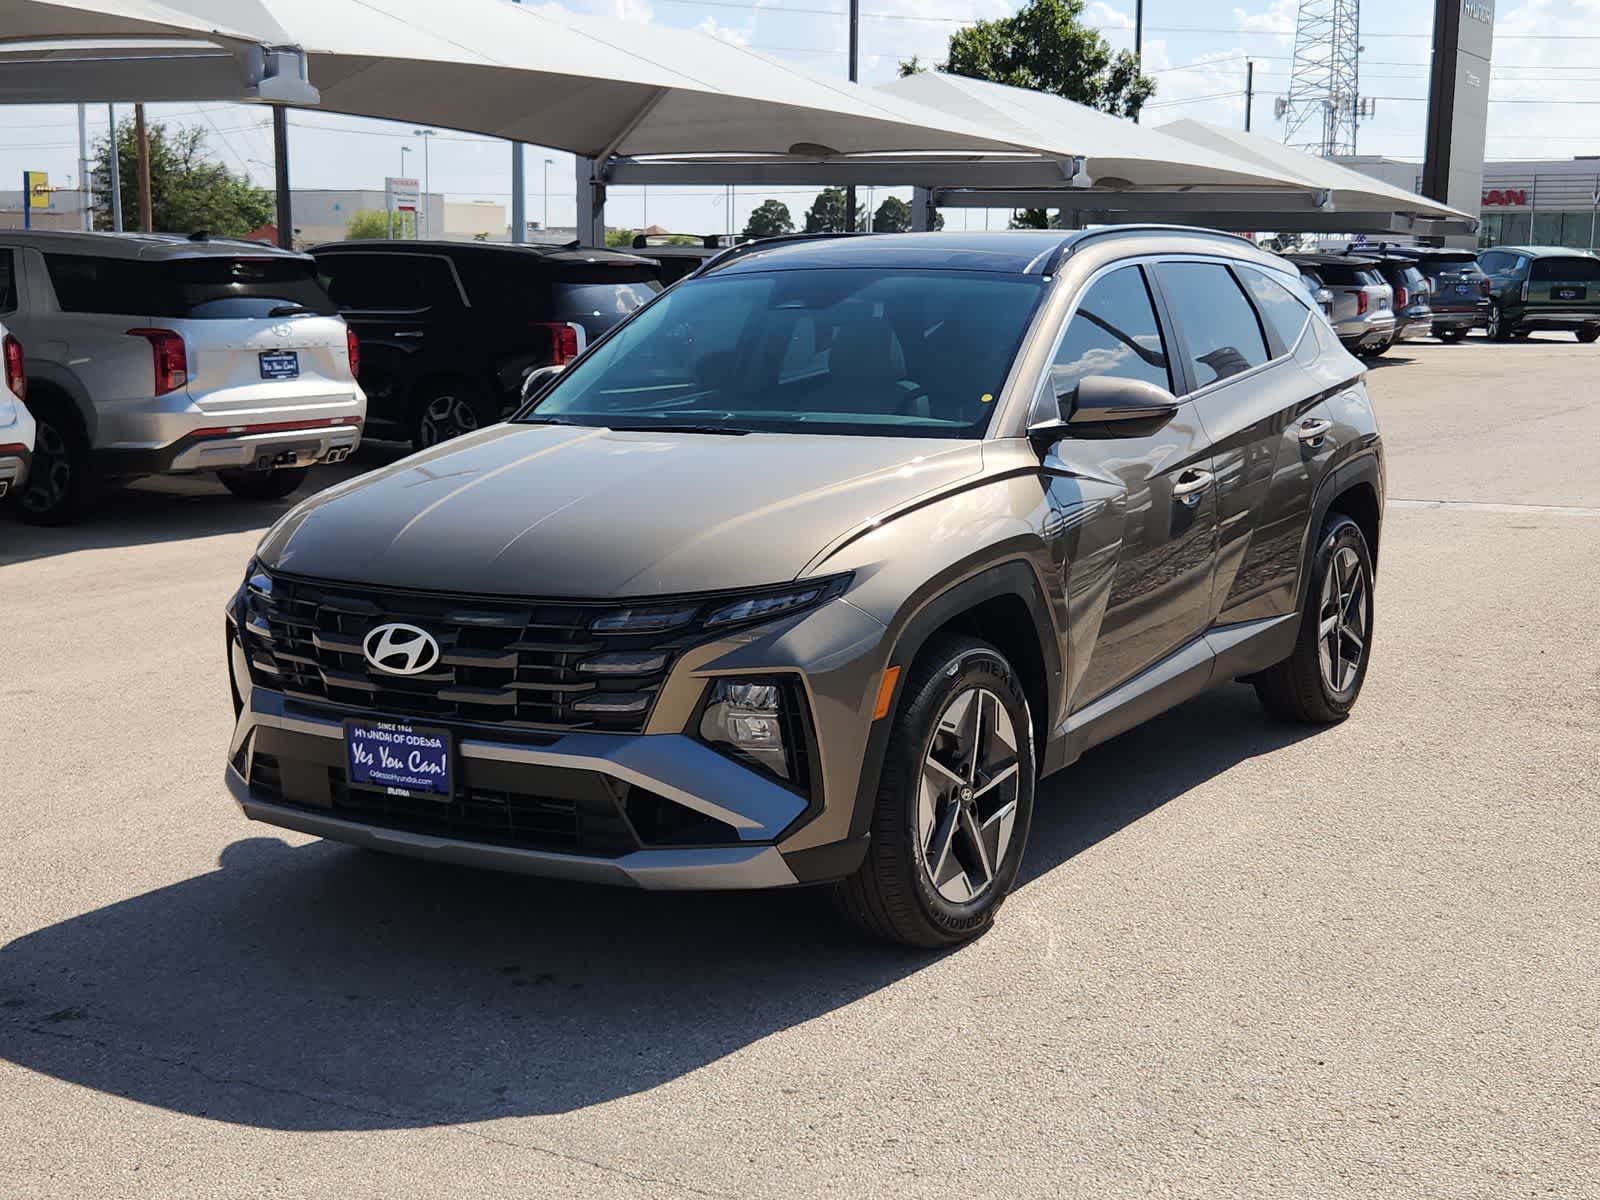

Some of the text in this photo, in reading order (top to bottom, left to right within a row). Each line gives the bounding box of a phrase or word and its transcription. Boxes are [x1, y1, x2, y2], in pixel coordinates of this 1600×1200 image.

[377, 722, 396, 731] SINCE
[354, 728, 442, 748] HYUNDAI OF ODESSA
[352, 742, 446, 776] Yes You Can!
